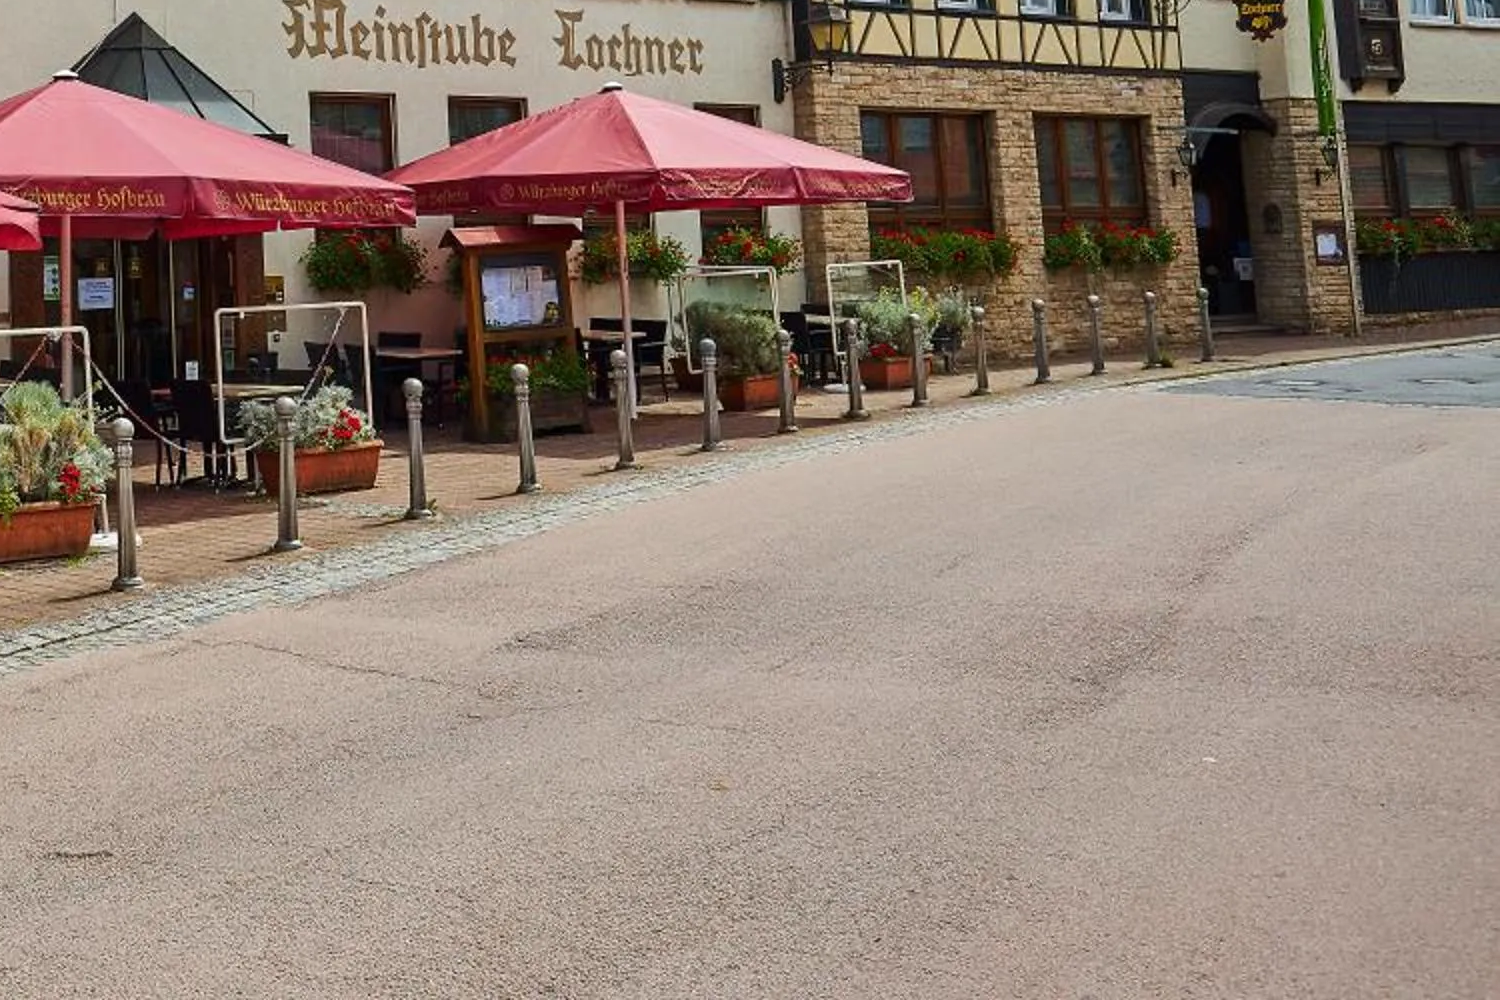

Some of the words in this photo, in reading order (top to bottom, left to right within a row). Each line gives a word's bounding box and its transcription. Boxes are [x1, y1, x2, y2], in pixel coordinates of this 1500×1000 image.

[552, 8, 703, 76] Lochner
[97, 186, 165, 211] Hofbräu
[236, 191, 327, 218] Würzburger
